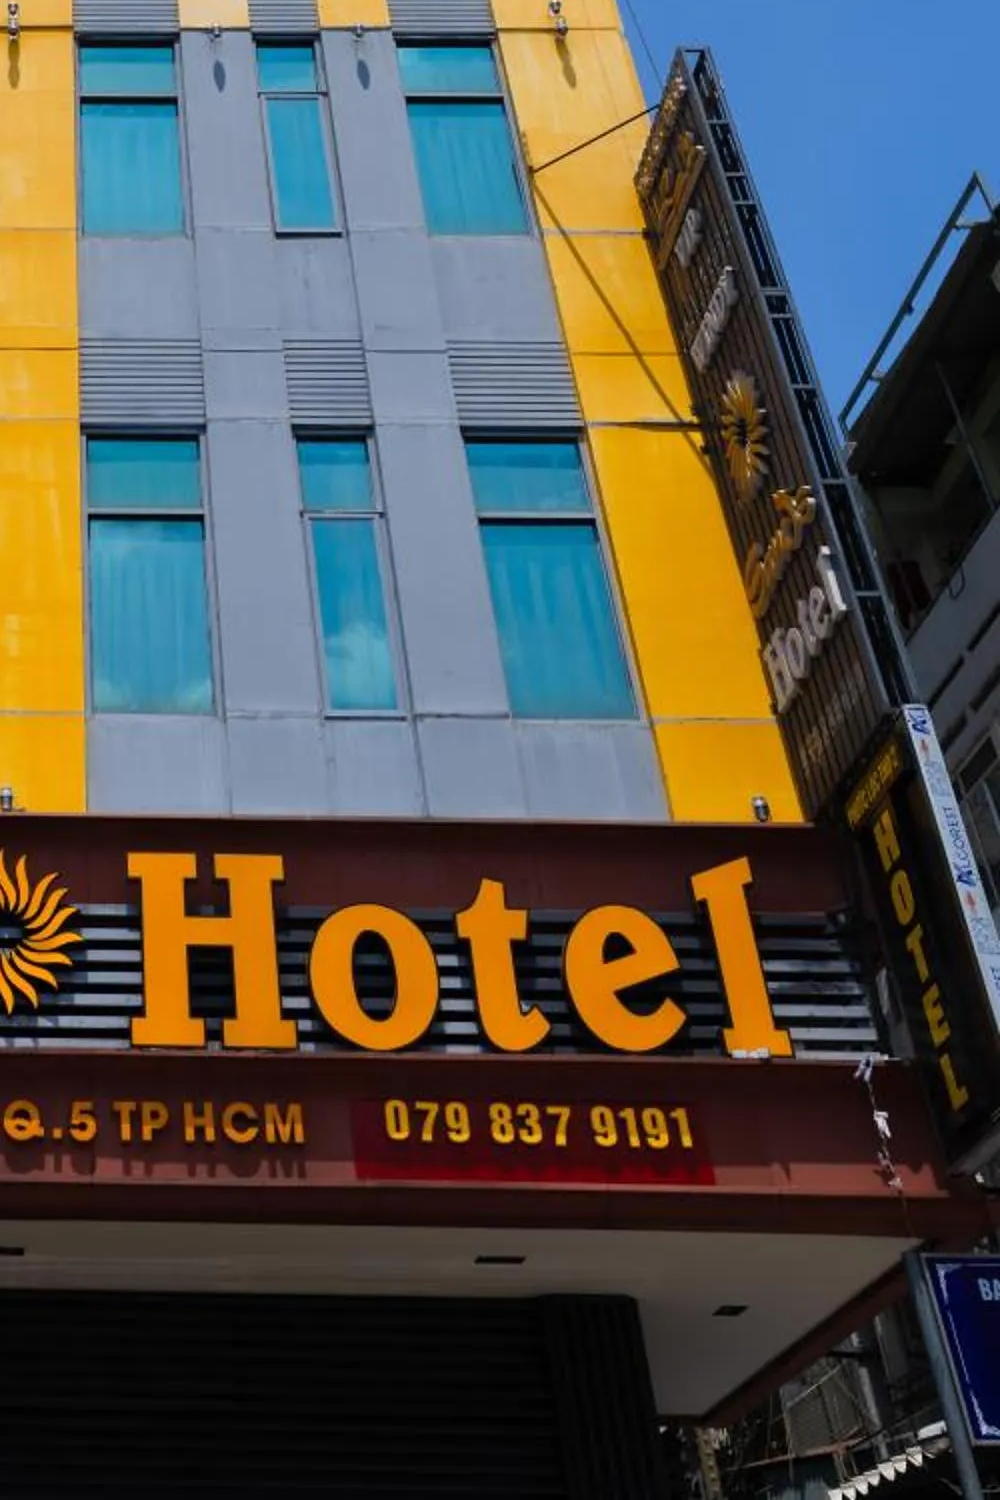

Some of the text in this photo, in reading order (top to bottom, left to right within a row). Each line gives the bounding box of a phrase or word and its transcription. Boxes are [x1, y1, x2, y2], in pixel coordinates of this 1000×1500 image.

[125, 850, 793, 1058] Hotel
[873, 804, 968, 1113] HOTEL
[2, 1099, 98, 1142] Q.5
[113, 1100, 169, 1143] TP
[183, 1101, 305, 1145] HCM
[383, 1099, 694, 1150] 079 837 9191
